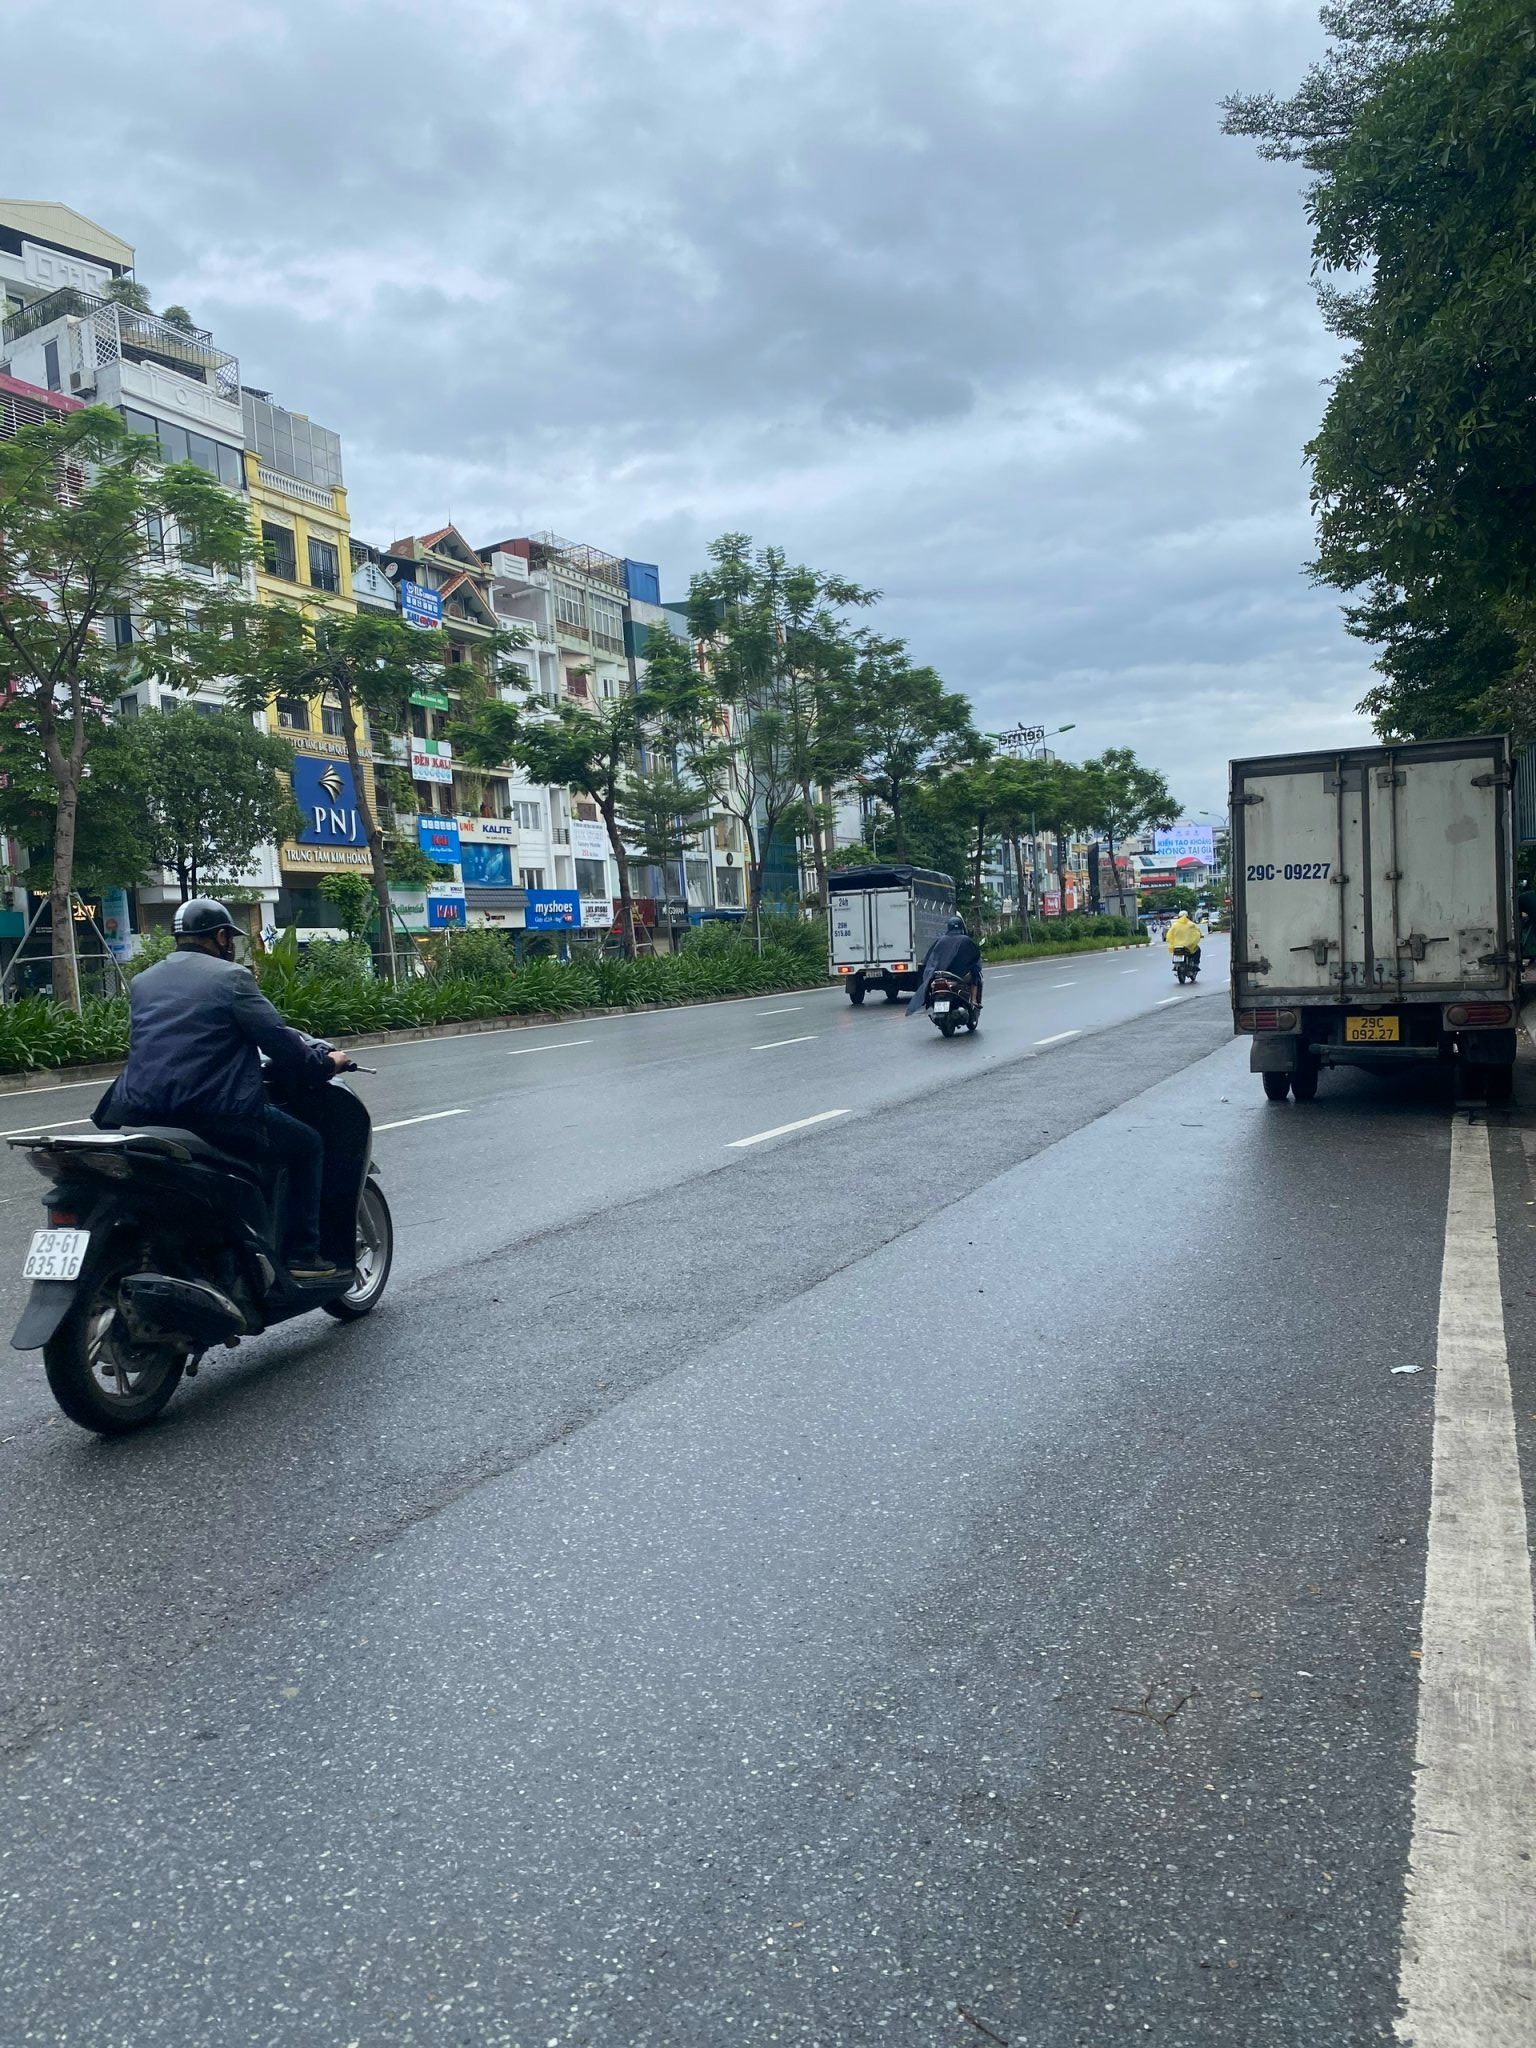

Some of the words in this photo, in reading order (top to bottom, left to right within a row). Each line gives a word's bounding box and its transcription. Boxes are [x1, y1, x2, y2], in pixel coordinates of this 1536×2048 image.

[313, 806, 356, 842] PNJ
[286, 849, 312, 861] TRUNG
[331, 852, 345, 863] KIM
[1247, 863, 1331, 881] 29C-09227
[535, 900, 573, 916] myshoes
[1361, 1018, 1384, 1028] 29C
[1352, 1029, 1393, 1040] 092.27
[25, 1255, 80, 1276] 835.16
